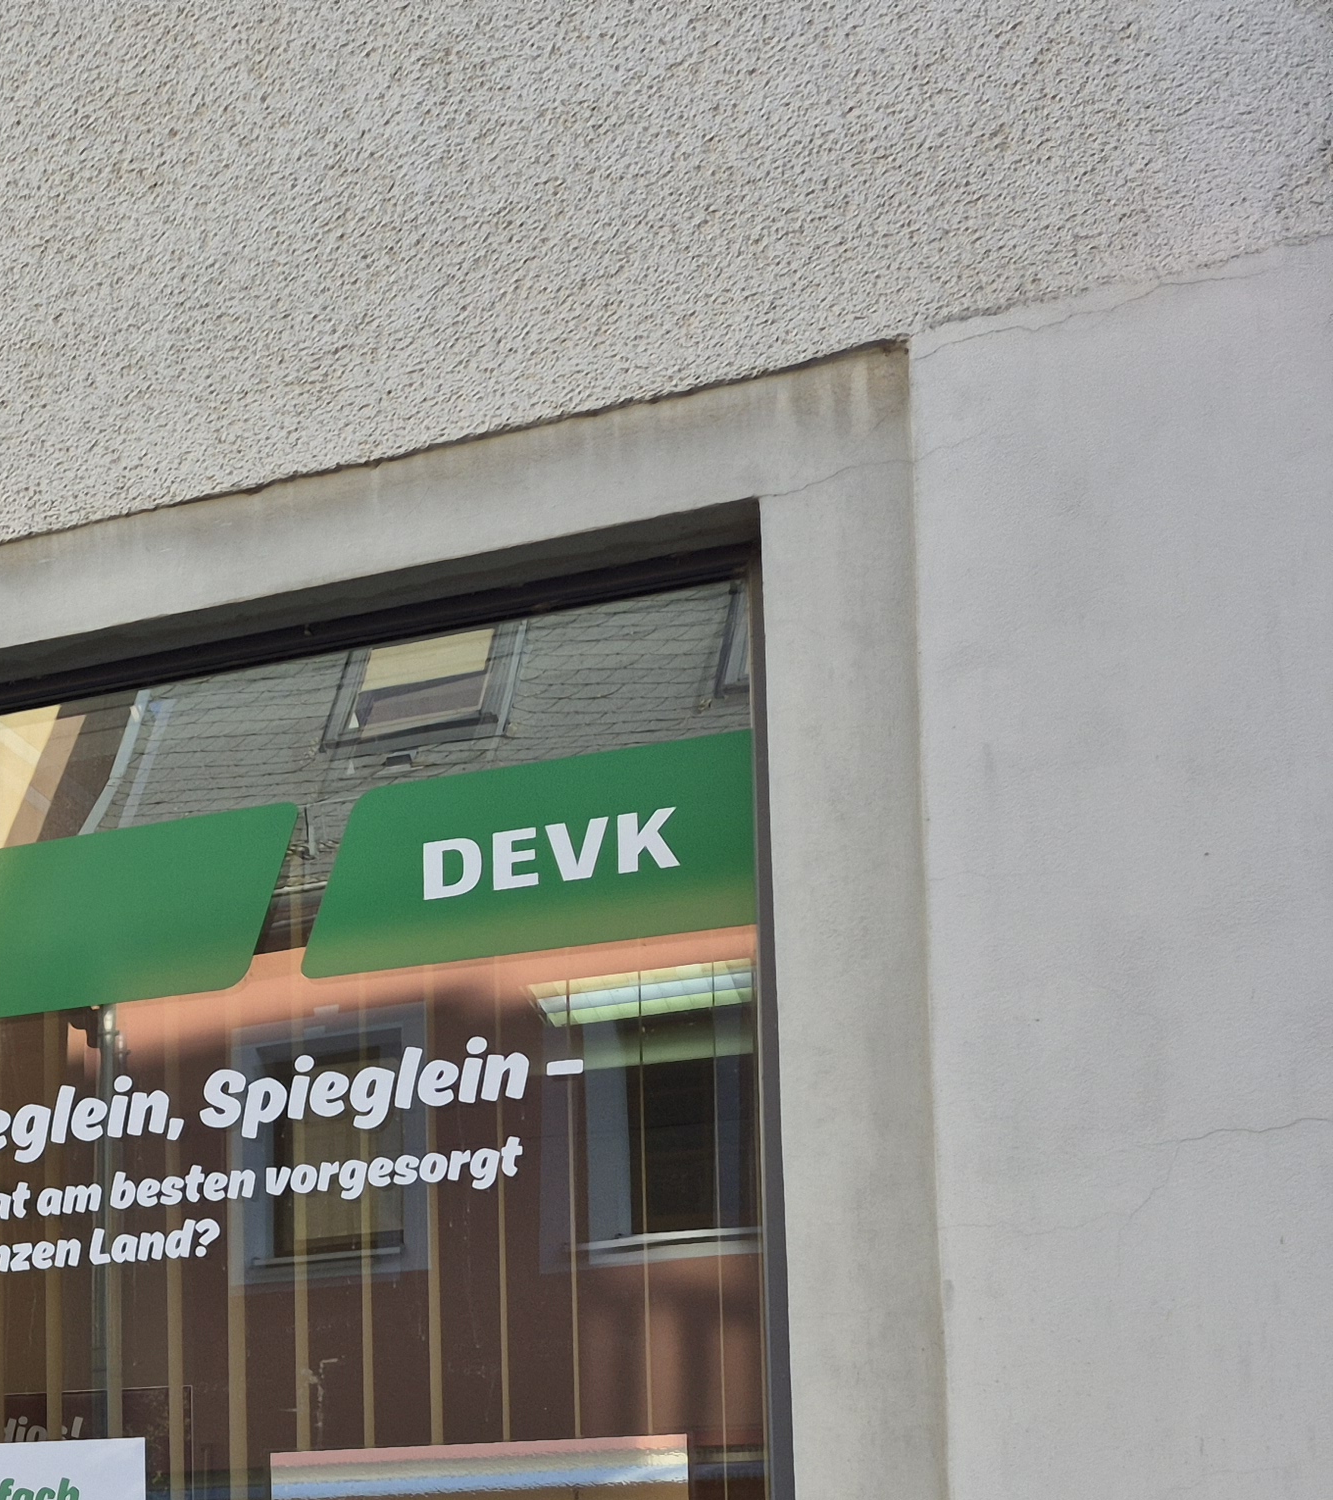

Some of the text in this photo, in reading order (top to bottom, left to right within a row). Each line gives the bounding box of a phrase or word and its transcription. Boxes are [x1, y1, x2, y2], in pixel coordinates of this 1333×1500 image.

[422, 806, 679, 901] DEVK
[199, 1035, 528, 1138] Spieglein
[38, 1180, 102, 1219] am
[109, 1162, 256, 1211] besten
[265, 1136, 524, 1200] vorgesorgt
[89, 1219, 221, 1266] Land?
